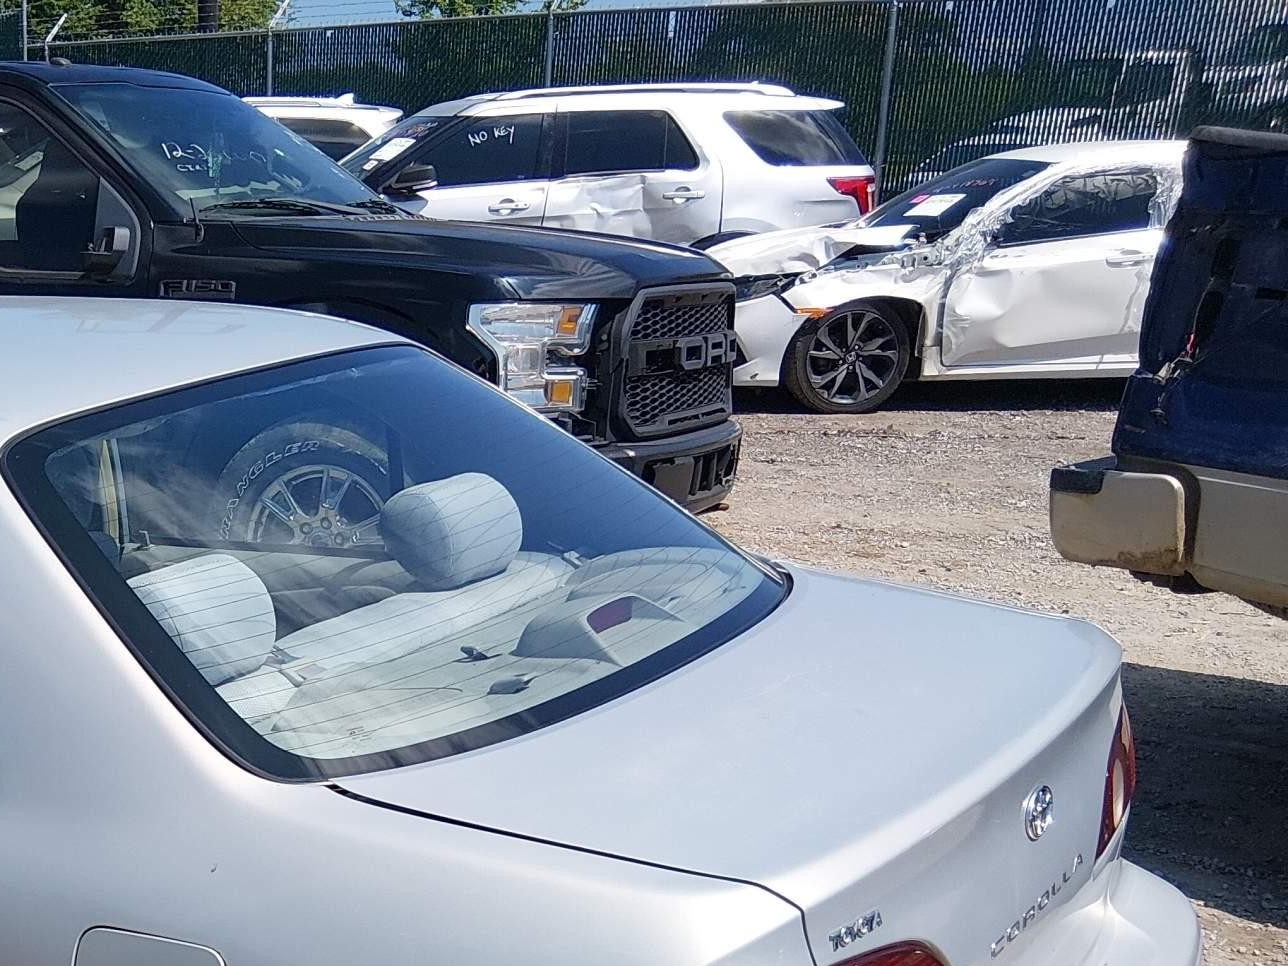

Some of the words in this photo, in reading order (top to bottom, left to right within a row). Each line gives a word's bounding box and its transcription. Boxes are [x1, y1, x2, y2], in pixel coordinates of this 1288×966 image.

[468, 131, 488, 147] NO
[493, 125, 515, 145] KEY
[990, 853, 1083, 960] COROLLA
[828, 910, 883, 952] TOYOTA
